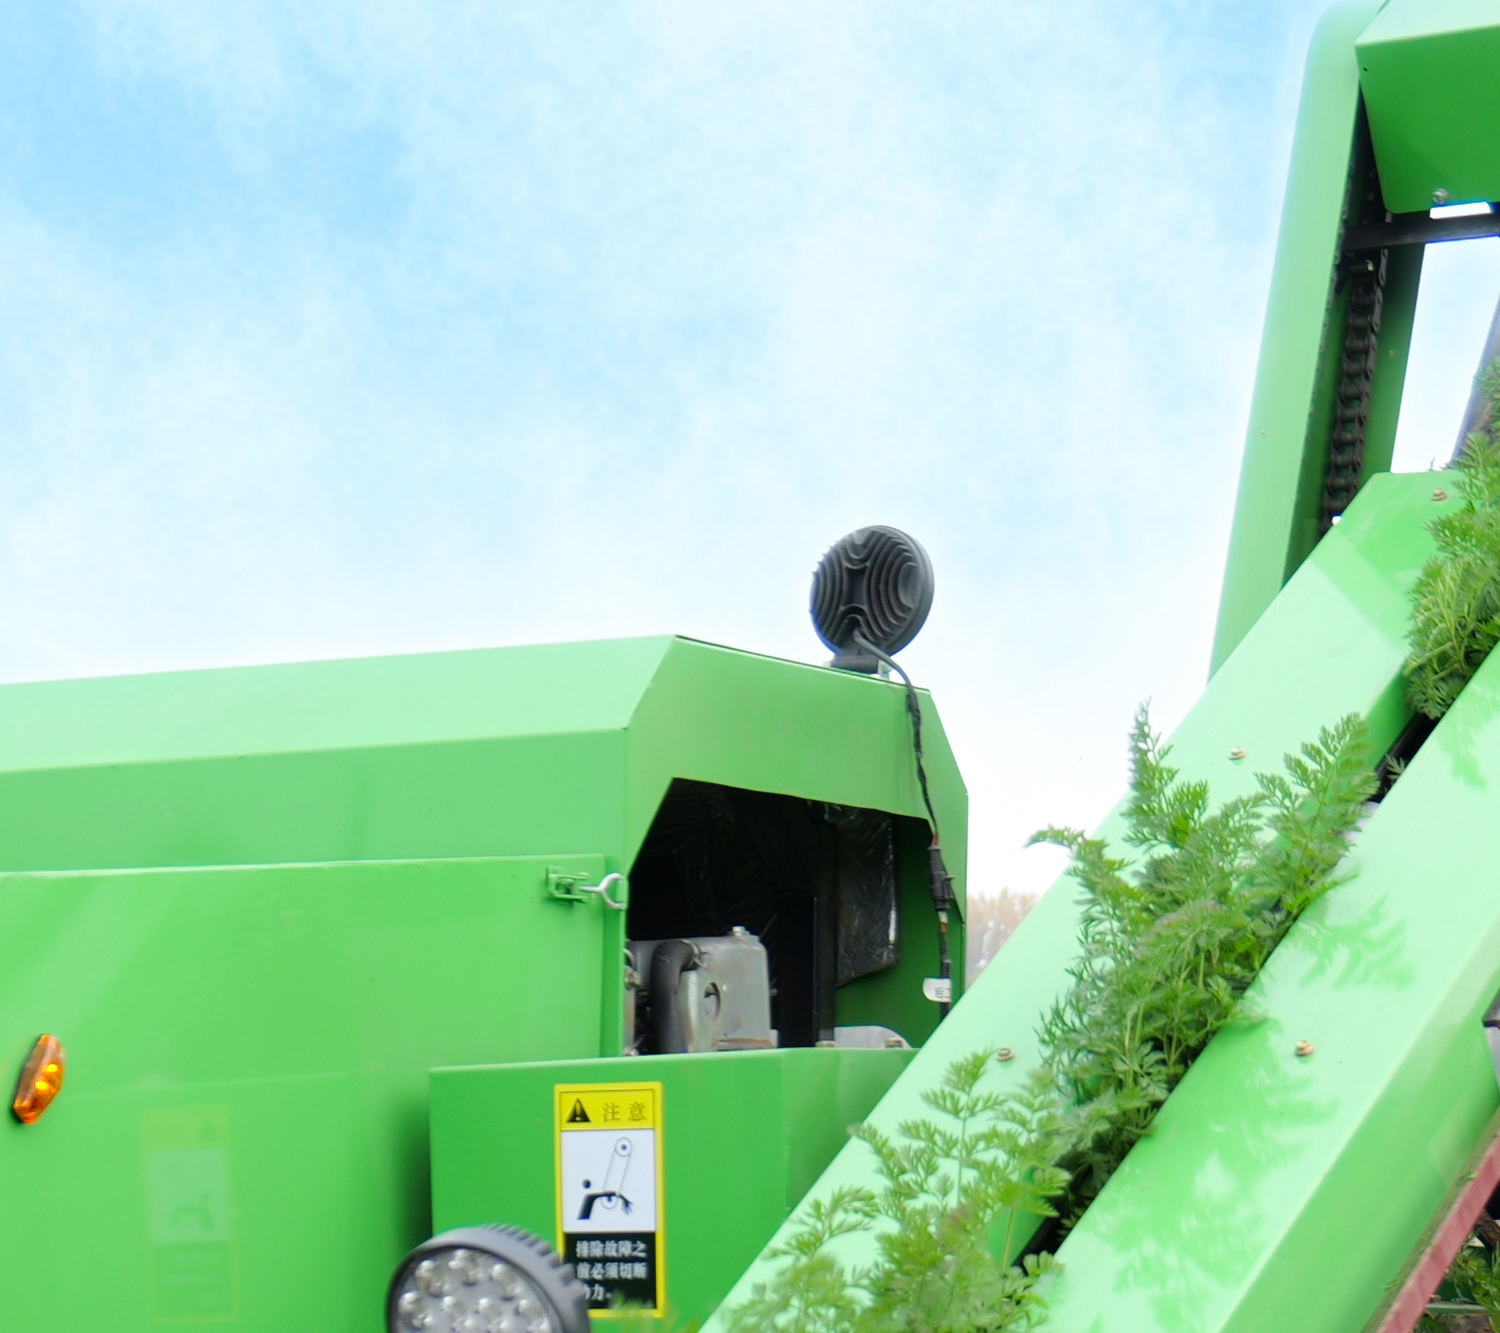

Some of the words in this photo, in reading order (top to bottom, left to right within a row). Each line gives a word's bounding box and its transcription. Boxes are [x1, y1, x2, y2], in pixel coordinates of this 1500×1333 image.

[602, 1101, 646, 1123] 注意
[575, 1239, 648, 1259] 排除故障之
[575, 1261, 648, 1281] 前必须切断
